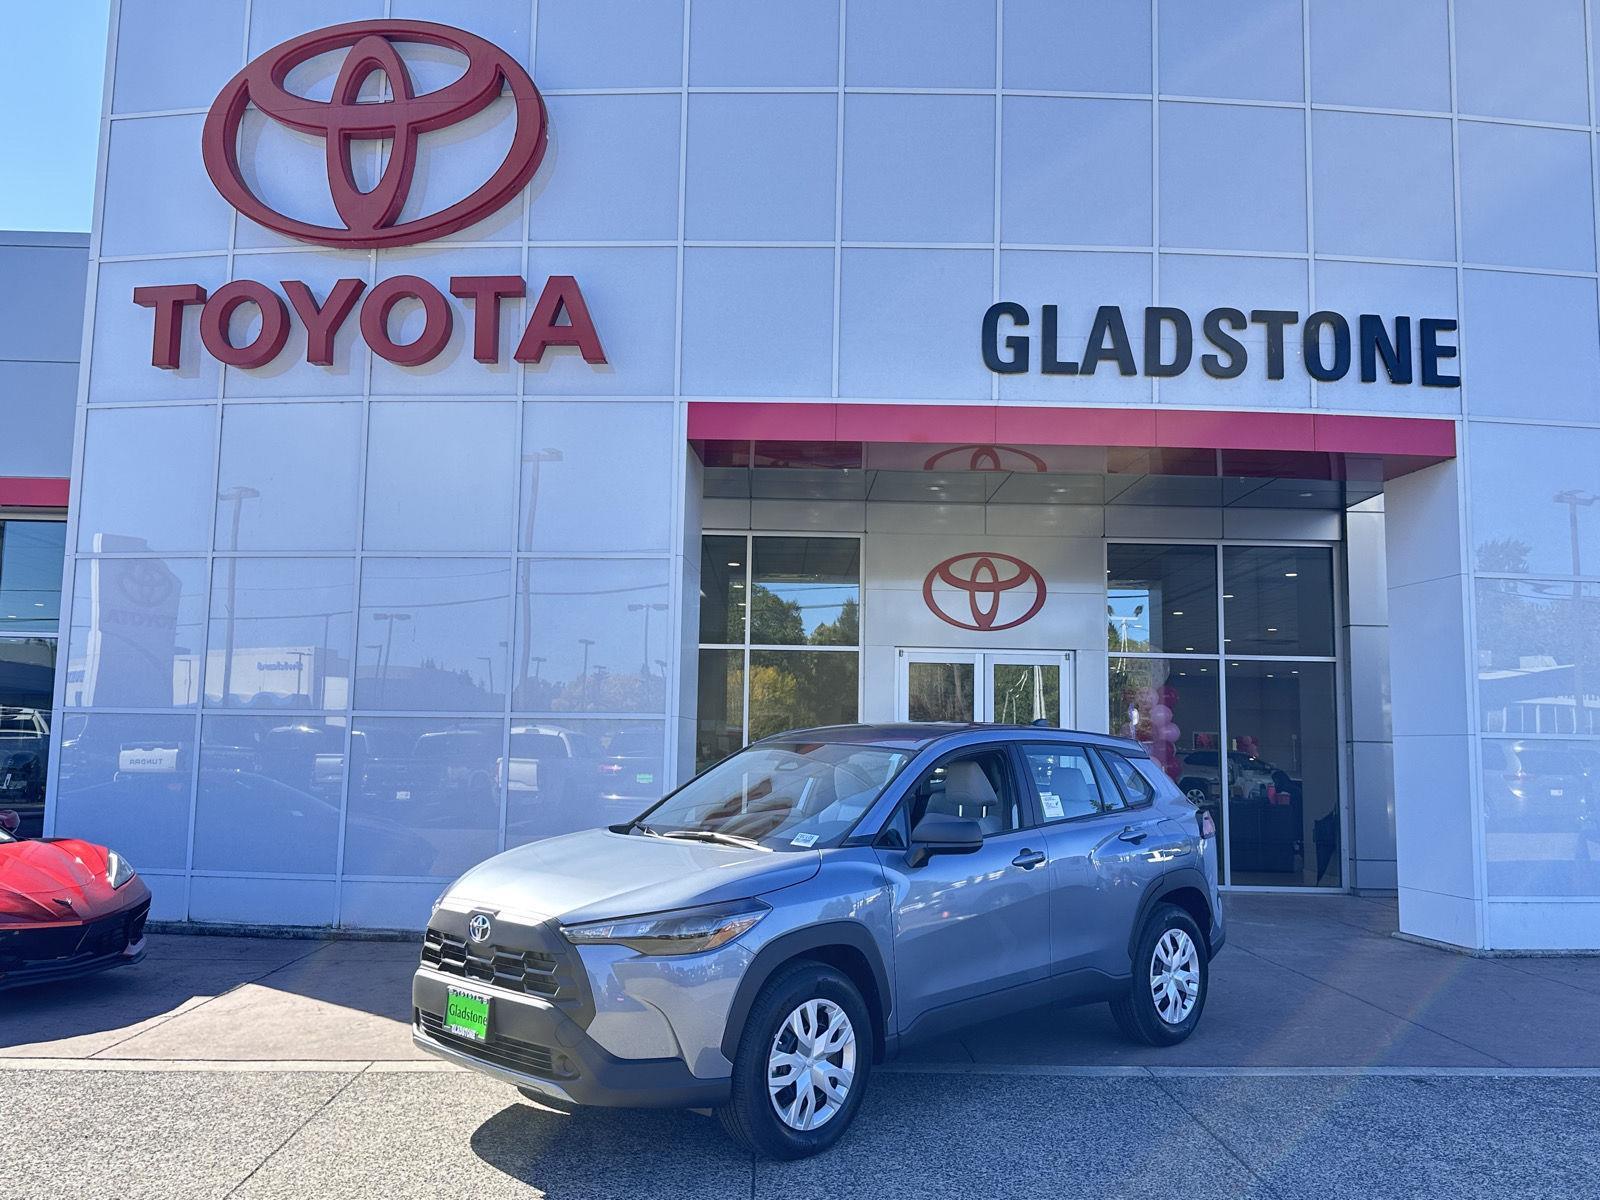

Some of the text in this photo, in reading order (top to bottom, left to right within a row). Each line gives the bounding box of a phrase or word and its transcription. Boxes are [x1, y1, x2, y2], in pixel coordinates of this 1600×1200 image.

[133, 275, 607, 370] TOYOTA
[981, 302, 1461, 387] GLADSTONE
[449, 1003, 488, 1026] Gladstone
